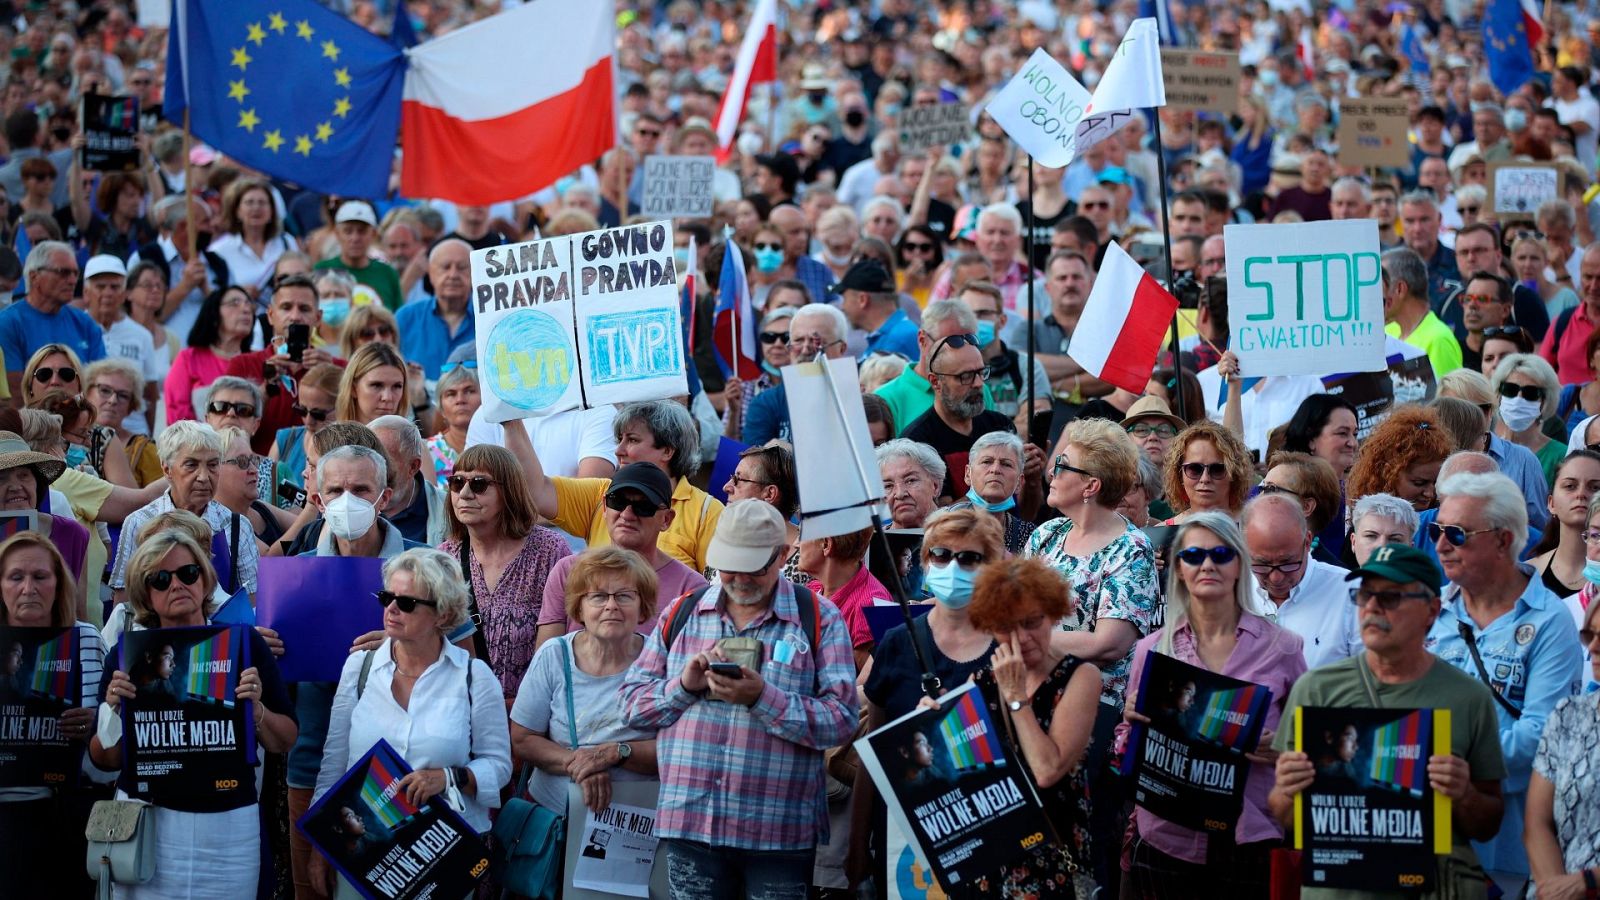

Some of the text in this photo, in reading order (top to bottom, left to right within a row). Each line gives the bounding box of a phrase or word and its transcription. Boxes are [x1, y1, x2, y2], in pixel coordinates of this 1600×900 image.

[581, 224, 666, 262] GÓWNO
[485, 241, 558, 278] SAMA
[581, 256, 677, 296] PRAWDA
[1244, 252, 1381, 322] STOP
[477, 271, 570, 314] PRAWDA
[597, 322, 665, 376] TVP
[1239, 323, 1345, 351] GWAŁTOM
[494, 342, 570, 391] tvn
[1375, 548, 1395, 561] H
[1, 716, 70, 741] LNE MED
[134, 709, 184, 722] WOLNI LUDZIE
[134, 720, 236, 748] WOLNE MEDIA
[1144, 737, 1188, 780] WOLNE
[1189, 758, 1236, 790] MEDIA
[215, 780, 238, 788] KOD
[914, 787, 964, 819] WOLNI LUDZIE
[919, 799, 977, 843] WOLNE
[971, 776, 1024, 818] MEDIA
[1311, 794, 1366, 808] WOLNI LUDZIE
[594, 807, 628, 830] WOLNE
[628, 813, 655, 837] MEDI
[1311, 807, 1423, 838] WOLNE MEDIA
[1020, 832, 1044, 849] KOD
[366, 843, 405, 884] WOLNI LUDZIE
[373, 854, 425, 899] WOLNE
[410, 818, 458, 863] MEDIA
[469, 857, 489, 878] KOD
[1399, 874, 1424, 884] KOD
